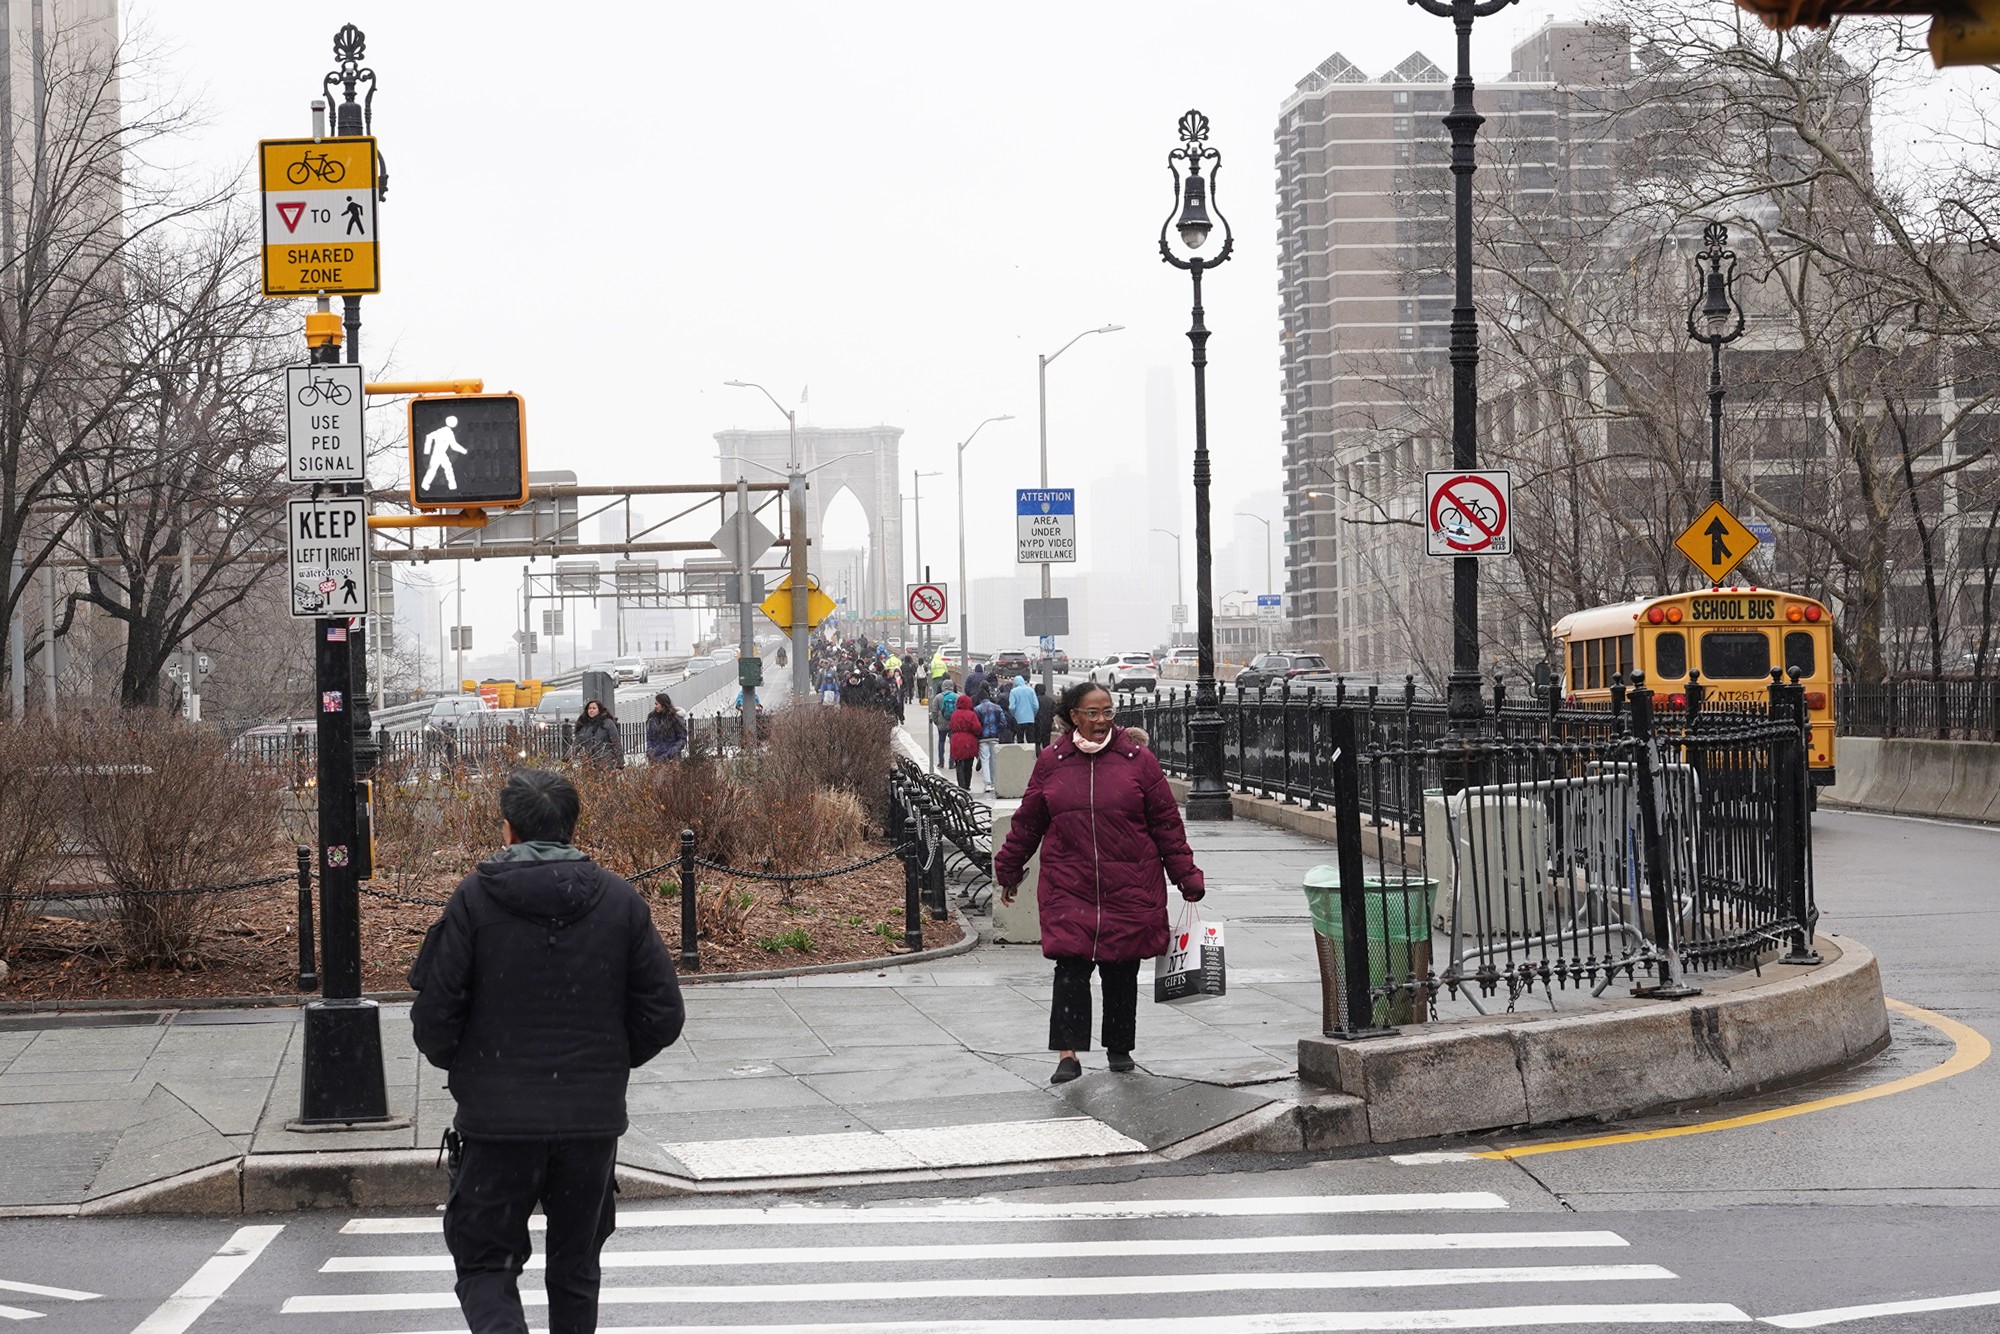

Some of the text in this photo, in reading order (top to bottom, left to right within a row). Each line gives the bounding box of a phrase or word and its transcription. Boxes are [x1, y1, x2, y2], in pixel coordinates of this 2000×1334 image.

[311, 209, 331, 223] TO
[288, 248, 354, 264] SHARED
[300, 268, 342, 284] ZONE
[312, 415, 340, 429] USE
[312, 436, 340, 450] PED
[299, 456, 354, 471] SIGNAL
[1020, 492, 1071, 501] ATTENTION
[300, 510, 356, 539] KEEP
[1033, 516, 1059, 525] AREA
[1031, 528, 1061, 536] UNDER
[1020, 539, 1073, 547] NYPD VIDEO
[297, 547, 361, 563] LEFT RIGHT
[1020, 550, 1073, 559] SURVEILLANCE
[1692, 599, 1775, 620] SCHOOL BUS
[1718, 690, 1764, 701] NT2617
[1173, 935, 1180, 953] I
[1167, 952, 1188, 974] NY
[1165, 973, 1187, 987] GIFTS
